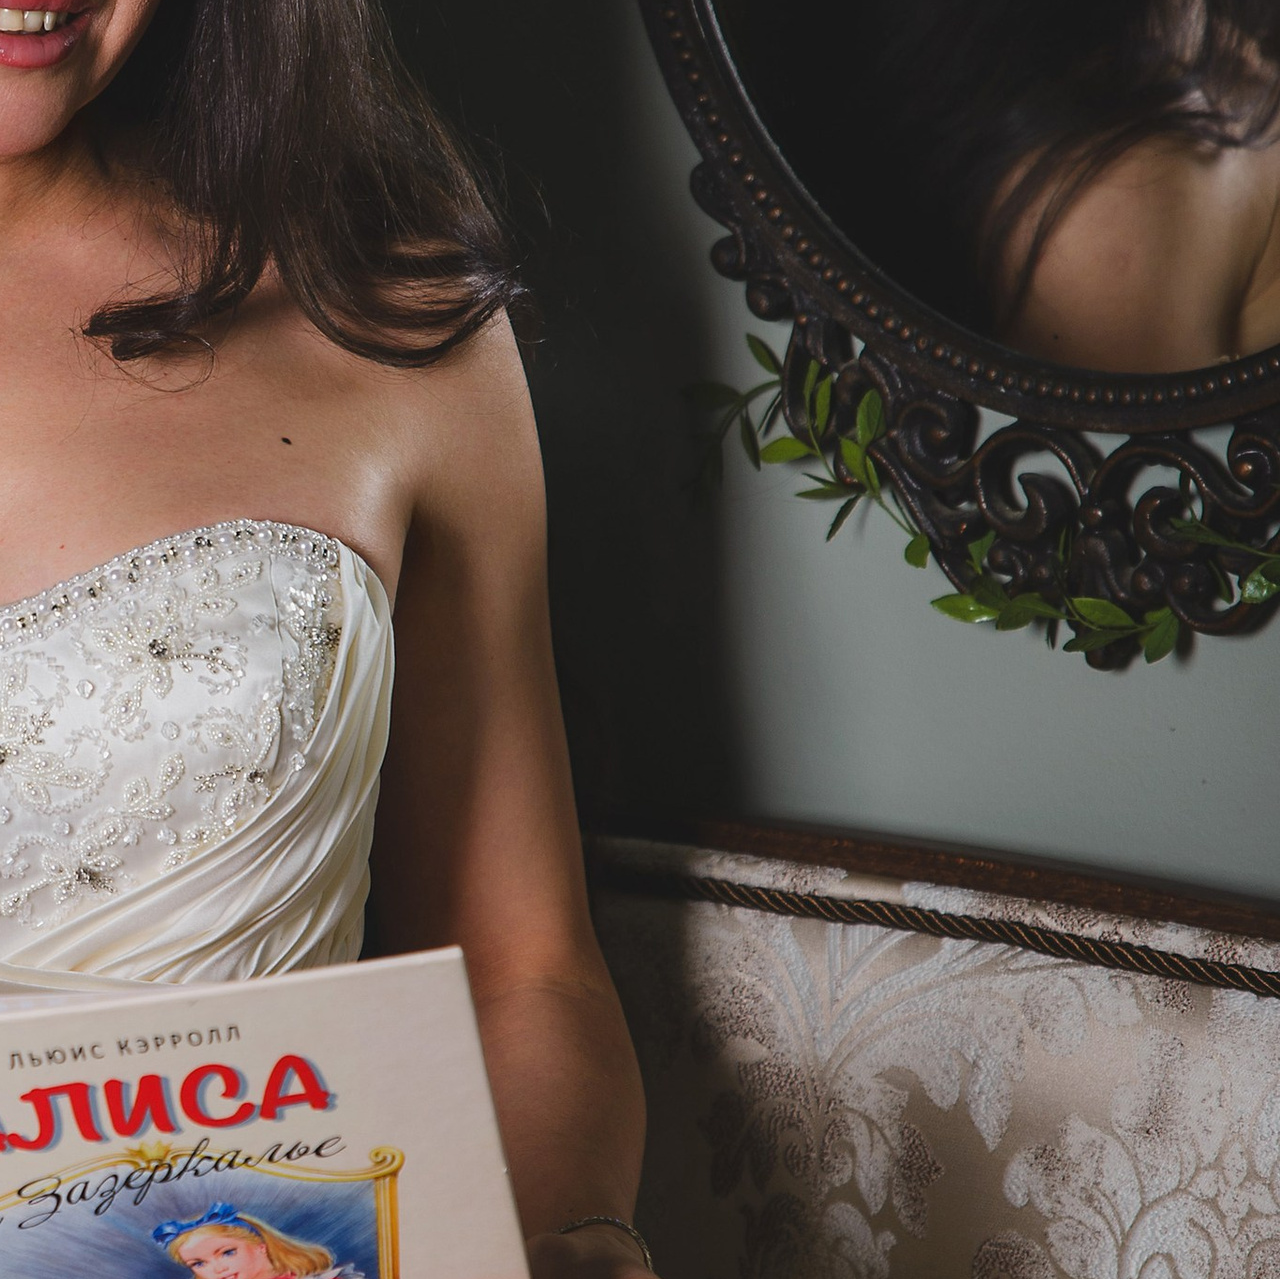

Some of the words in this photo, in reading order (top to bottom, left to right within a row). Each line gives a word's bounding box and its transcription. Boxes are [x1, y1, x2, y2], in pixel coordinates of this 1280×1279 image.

[9, 1044, 106, 1071] ЛЬЮИС
[118, 1024, 241, 1058] КЭРРОЛЛ
[17, 1135, 346, 1231] Зазеркалье
